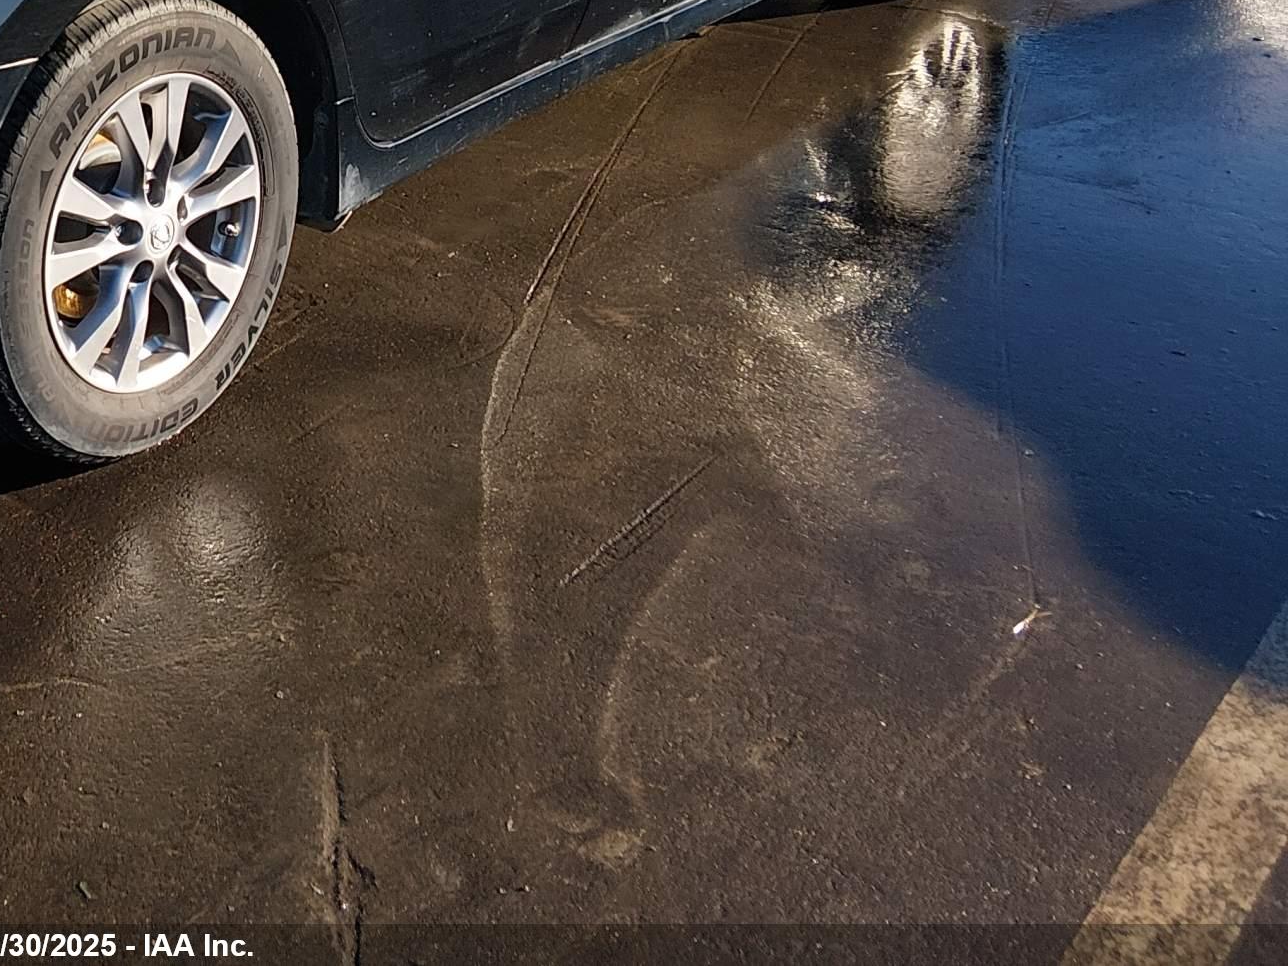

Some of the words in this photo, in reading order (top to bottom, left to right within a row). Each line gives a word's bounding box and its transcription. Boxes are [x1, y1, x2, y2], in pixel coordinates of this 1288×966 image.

[49, 27, 217, 160] ARIZONIAN
[215, 263, 282, 391] SILVER
[84, 397, 199, 444] EDITION
